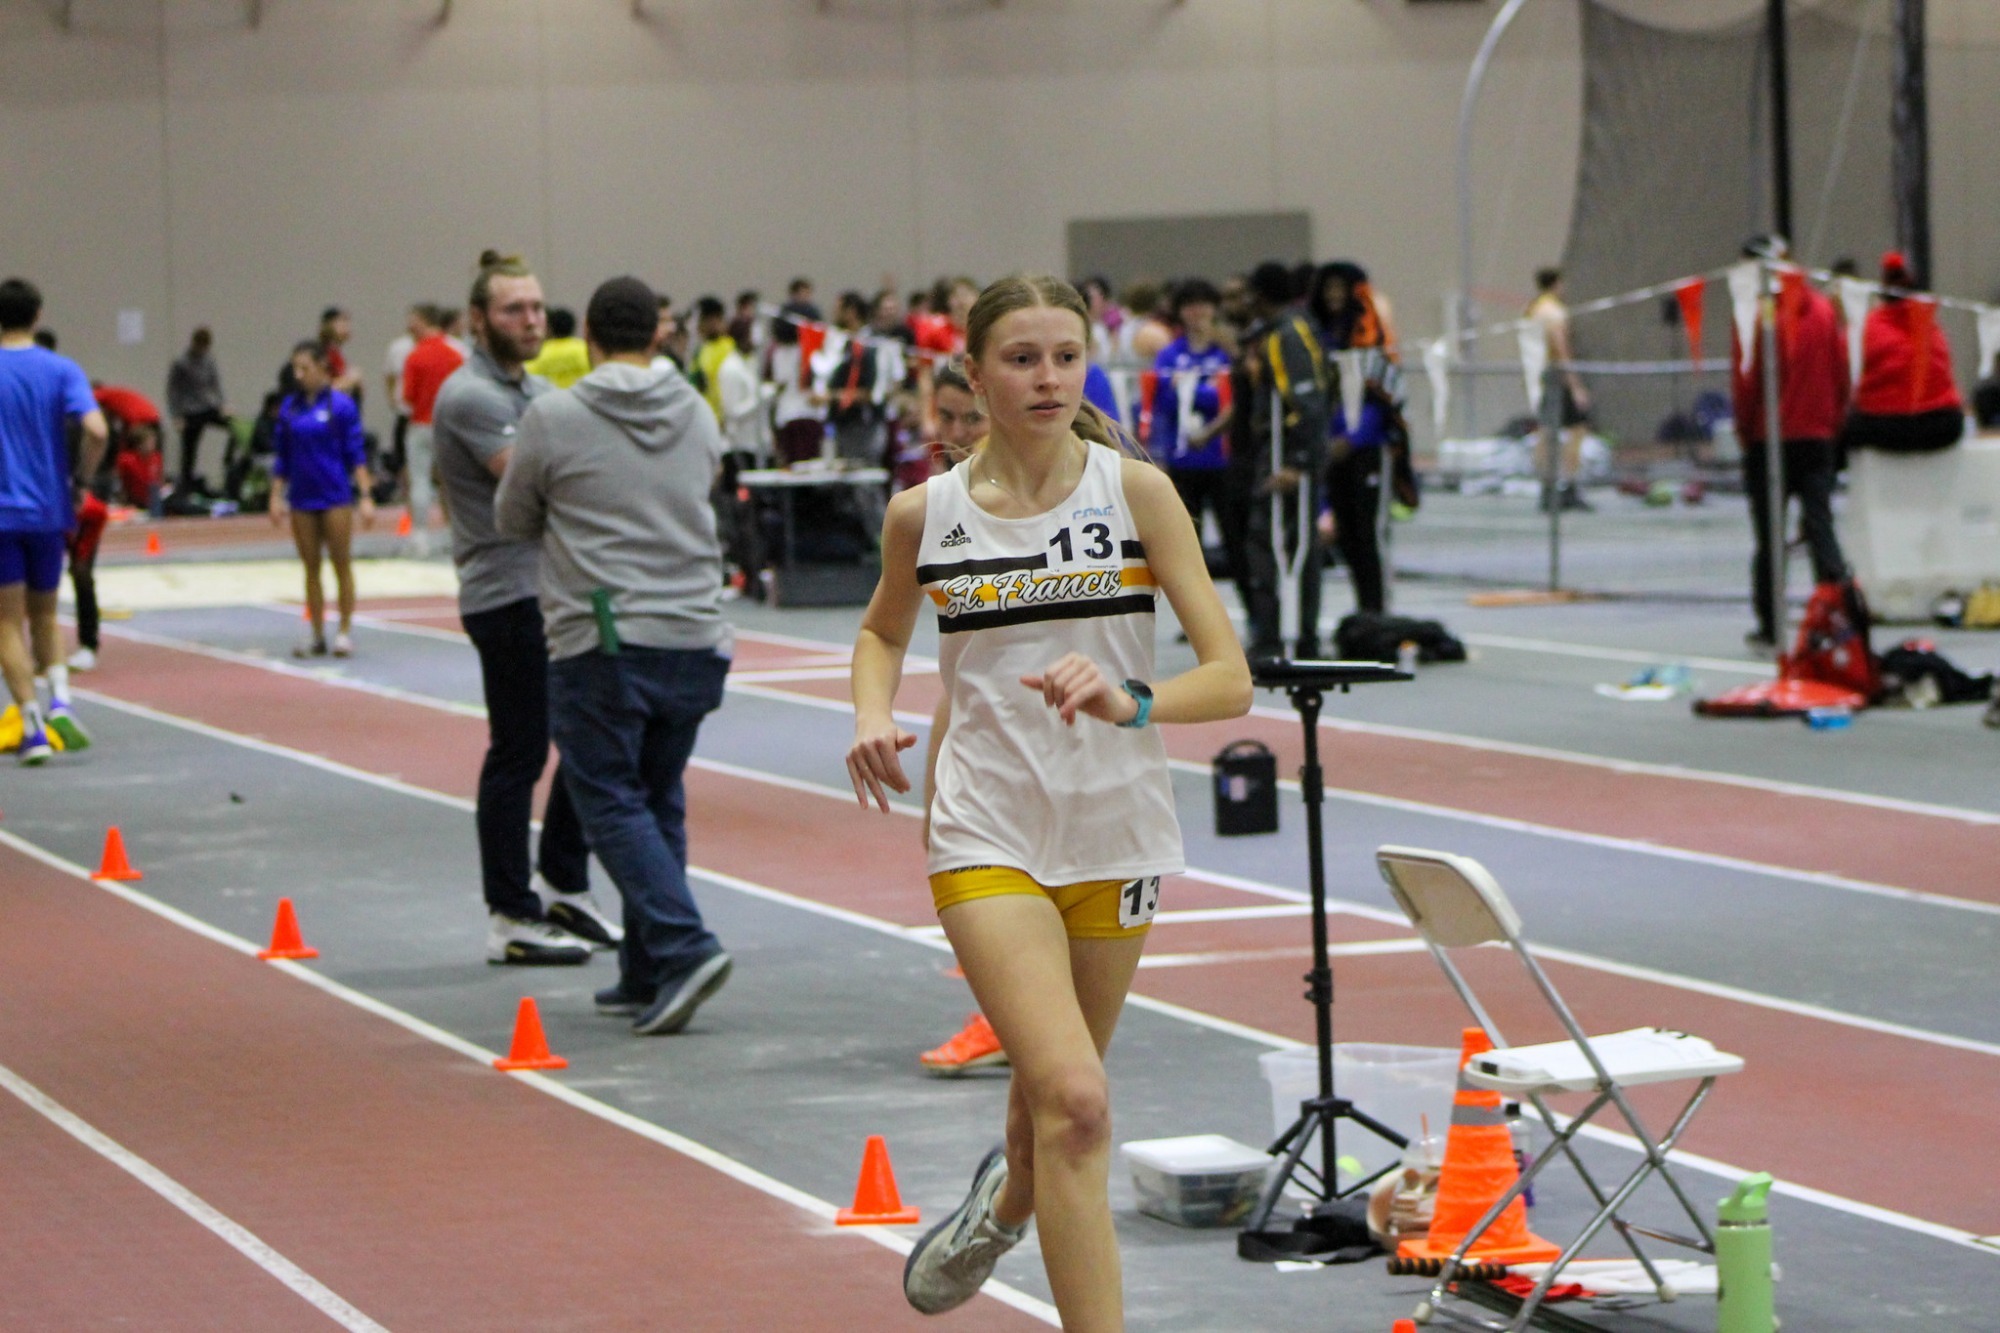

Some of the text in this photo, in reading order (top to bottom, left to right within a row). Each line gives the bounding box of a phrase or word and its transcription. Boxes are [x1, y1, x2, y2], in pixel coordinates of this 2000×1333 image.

[940, 536, 972, 548] adidas
[1049, 522, 1113, 562] 13
[941, 569, 1122, 619] St. Francis
[1124, 875, 1160, 915] 13
